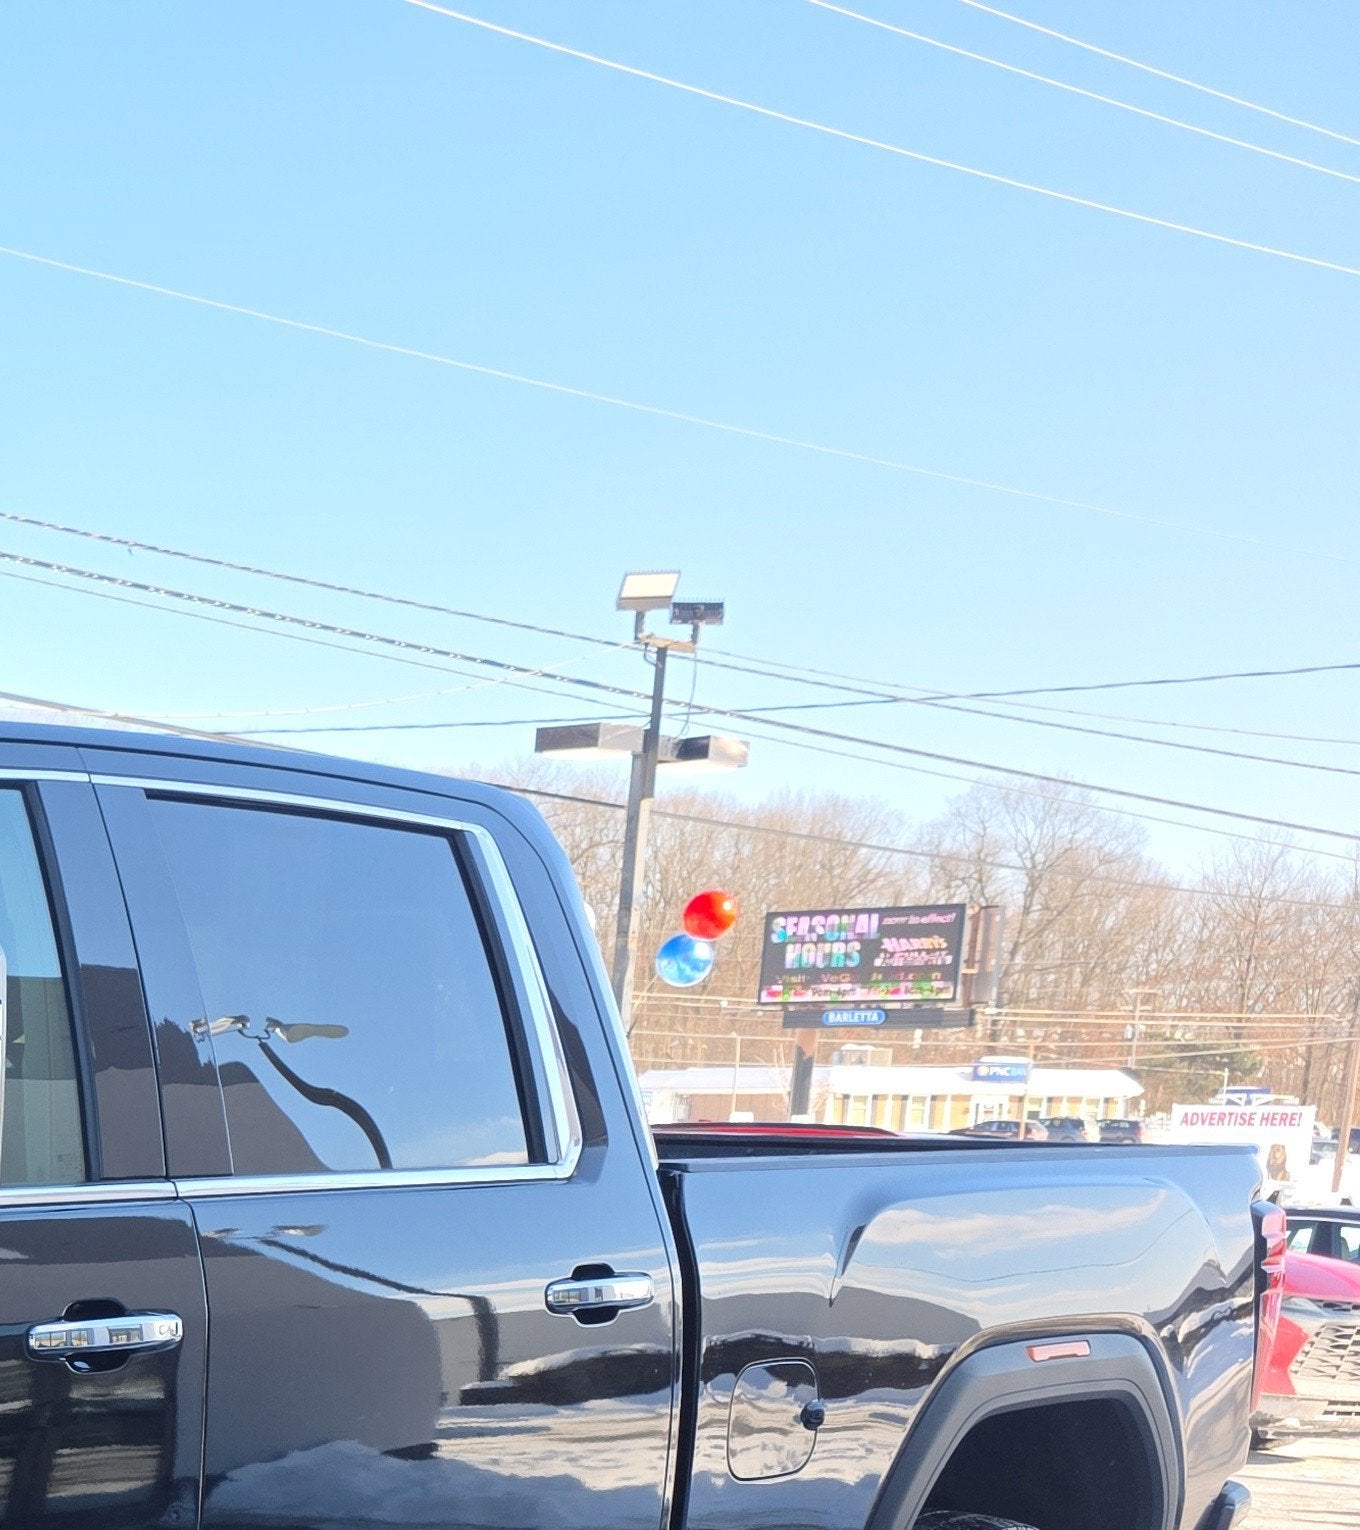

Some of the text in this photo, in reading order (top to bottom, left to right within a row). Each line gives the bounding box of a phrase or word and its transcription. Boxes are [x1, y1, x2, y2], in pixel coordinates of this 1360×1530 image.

[771, 913, 880, 944] SEASONAL
[785, 941, 861, 969] HOURS
[827, 1011, 880, 1024] BARLETTA
[1180, 1112, 1303, 1127] ADVERTISE HERE!
